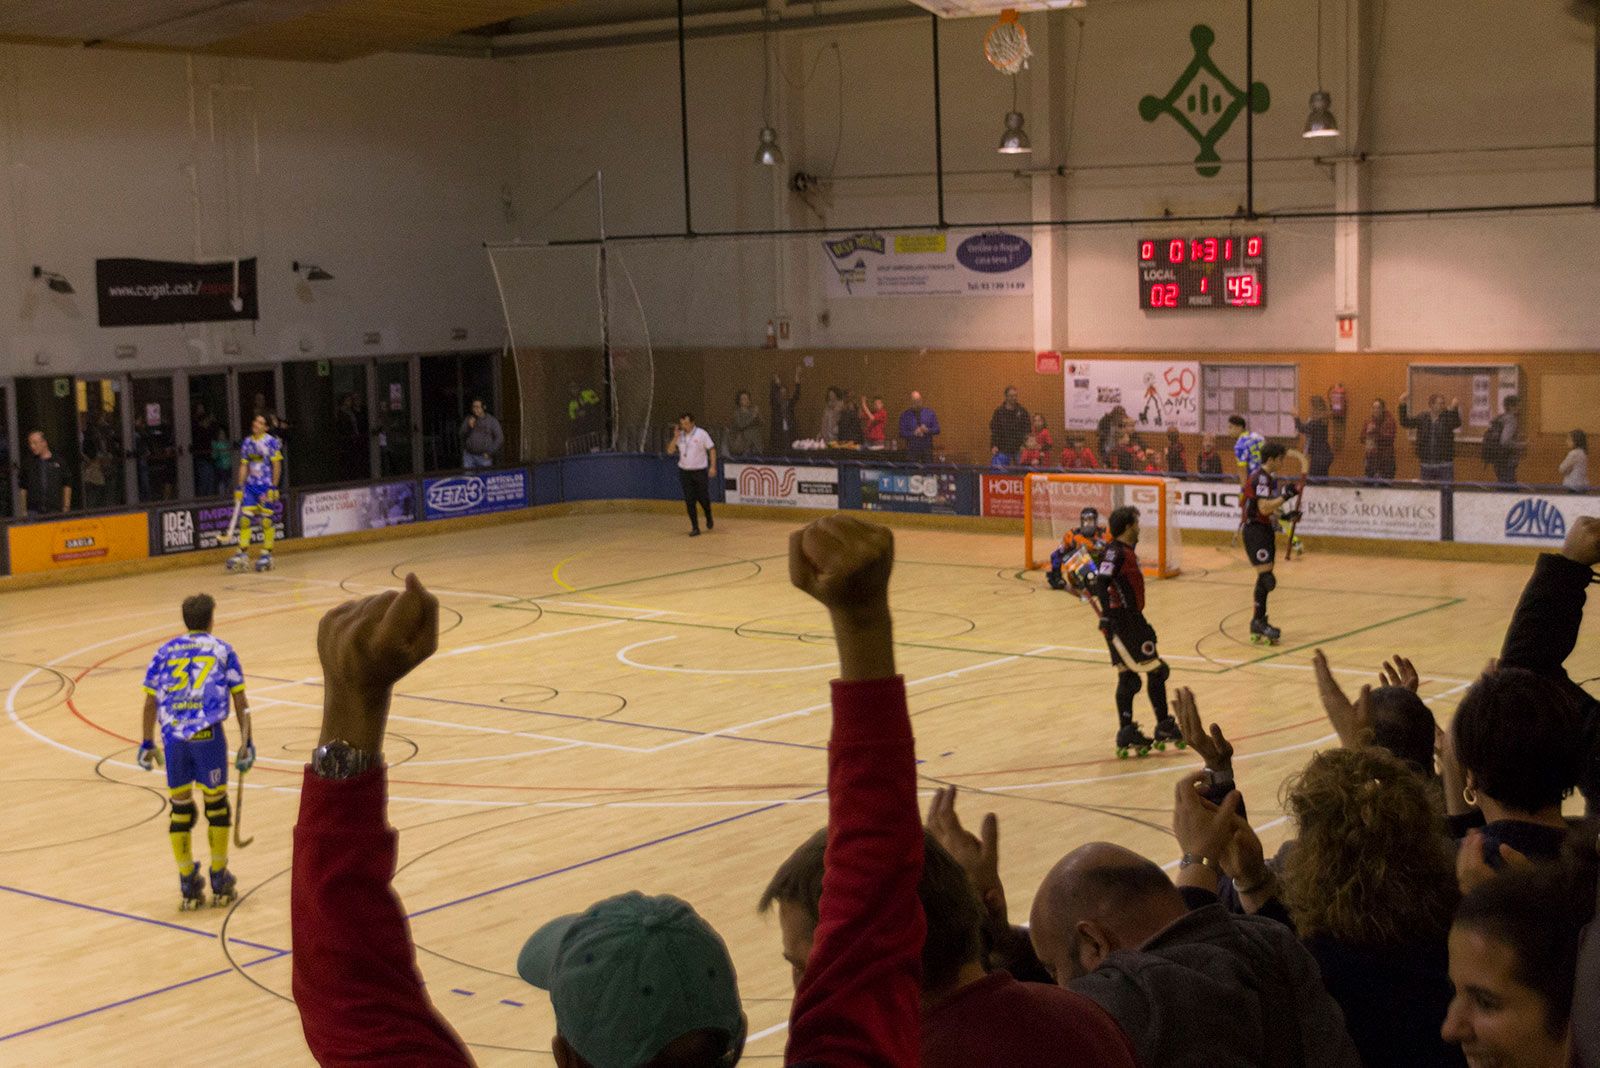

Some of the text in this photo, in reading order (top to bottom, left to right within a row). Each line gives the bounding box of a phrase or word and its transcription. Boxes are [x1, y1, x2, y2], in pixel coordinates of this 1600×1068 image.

[1141, 240, 1154, 260] 0
[1247, 236, 1262, 256] 0
[1144, 269, 1176, 281] LOCAL
[1150, 275, 1253, 307] 02 1 45
[1163, 367, 1196, 397] 50
[989, 479, 1025, 494] HOTEL
[163, 510, 194, 532] IDEA
[1351, 503, 1436, 519] AROMATICS
[164, 530, 194, 547] PRINT
[167, 655, 217, 692] 37
